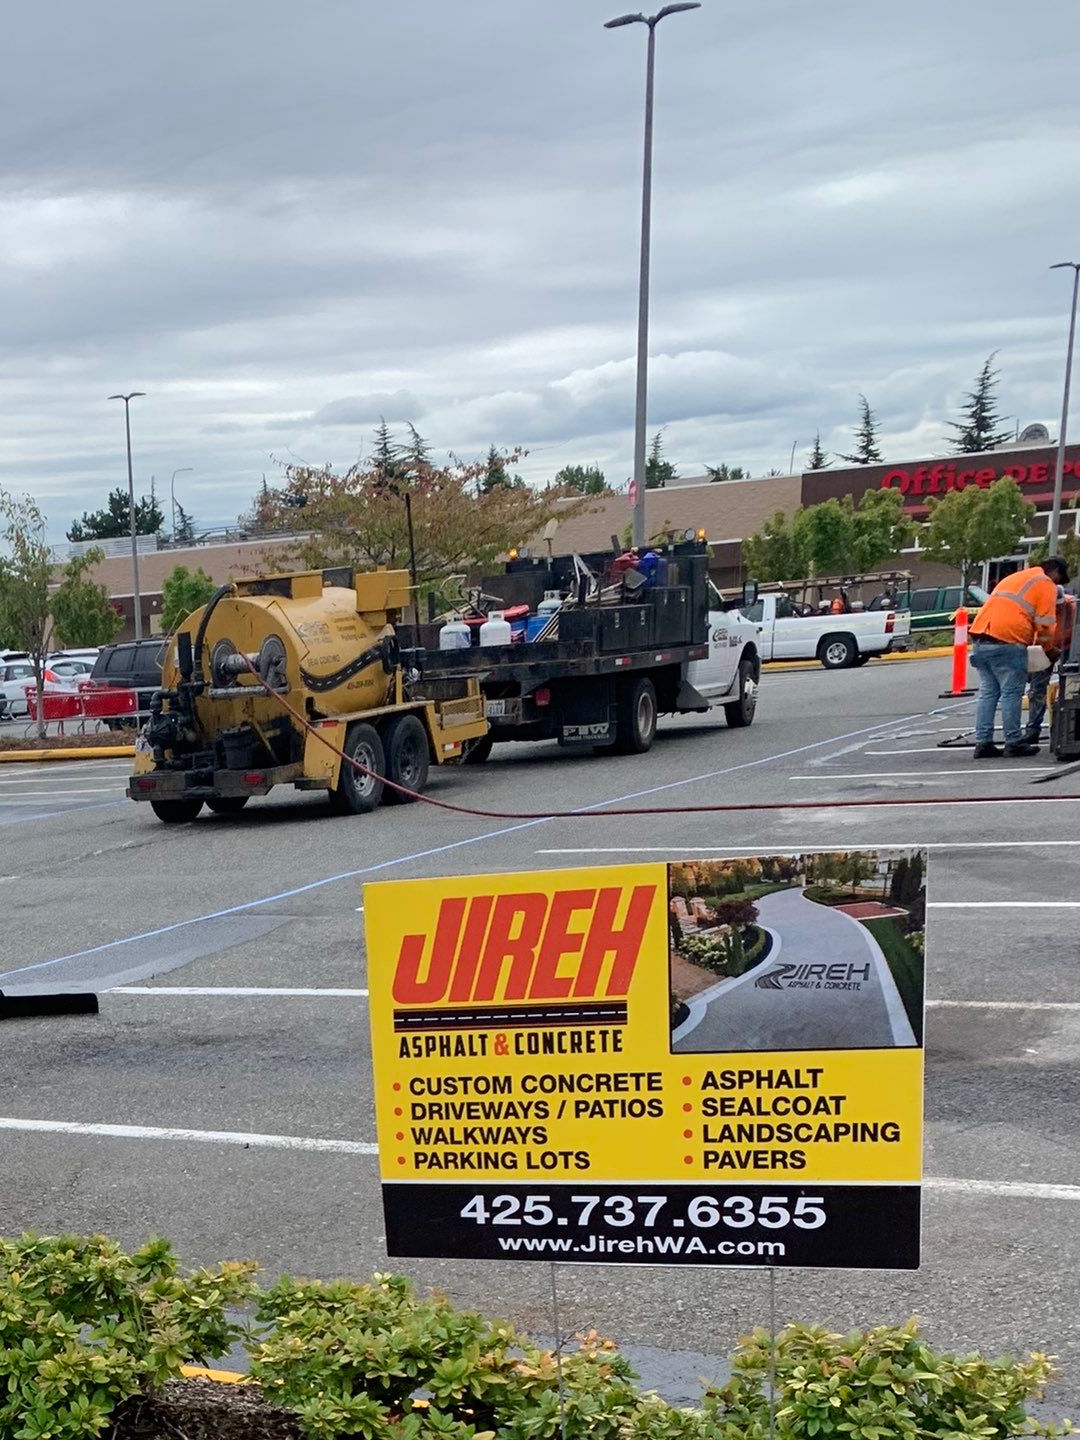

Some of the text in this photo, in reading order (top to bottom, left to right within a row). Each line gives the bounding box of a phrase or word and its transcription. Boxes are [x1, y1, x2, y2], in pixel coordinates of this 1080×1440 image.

[881, 463, 996, 495] Office
[392, 885, 658, 1005] JIREH
[782, 962, 870, 981] JIREH
[787, 981, 814, 989] ASPHALT
[824, 981, 861, 991] CONCRETE
[399, 1029, 623, 1058] ASPHALT & CONCRETE
[409, 1072, 663, 1096] CUSTOM CONCRETE
[701, 1068, 824, 1090] ASPHALT
[411, 1100, 550, 1120] DRIVEWAYS
[574, 1098, 664, 1118] PATIOS
[702, 1095, 846, 1117] SEALCOAT
[411, 1126, 548, 1145] WALKWAYS
[703, 1122, 901, 1143] LANDSCAPING
[414, 1151, 591, 1170] PARKING LOTS
[703, 1150, 807, 1169] PAVERS
[460, 1194, 827, 1229] 425.737.6355
[498, 1235, 786, 1256] www.JirehWA.com
